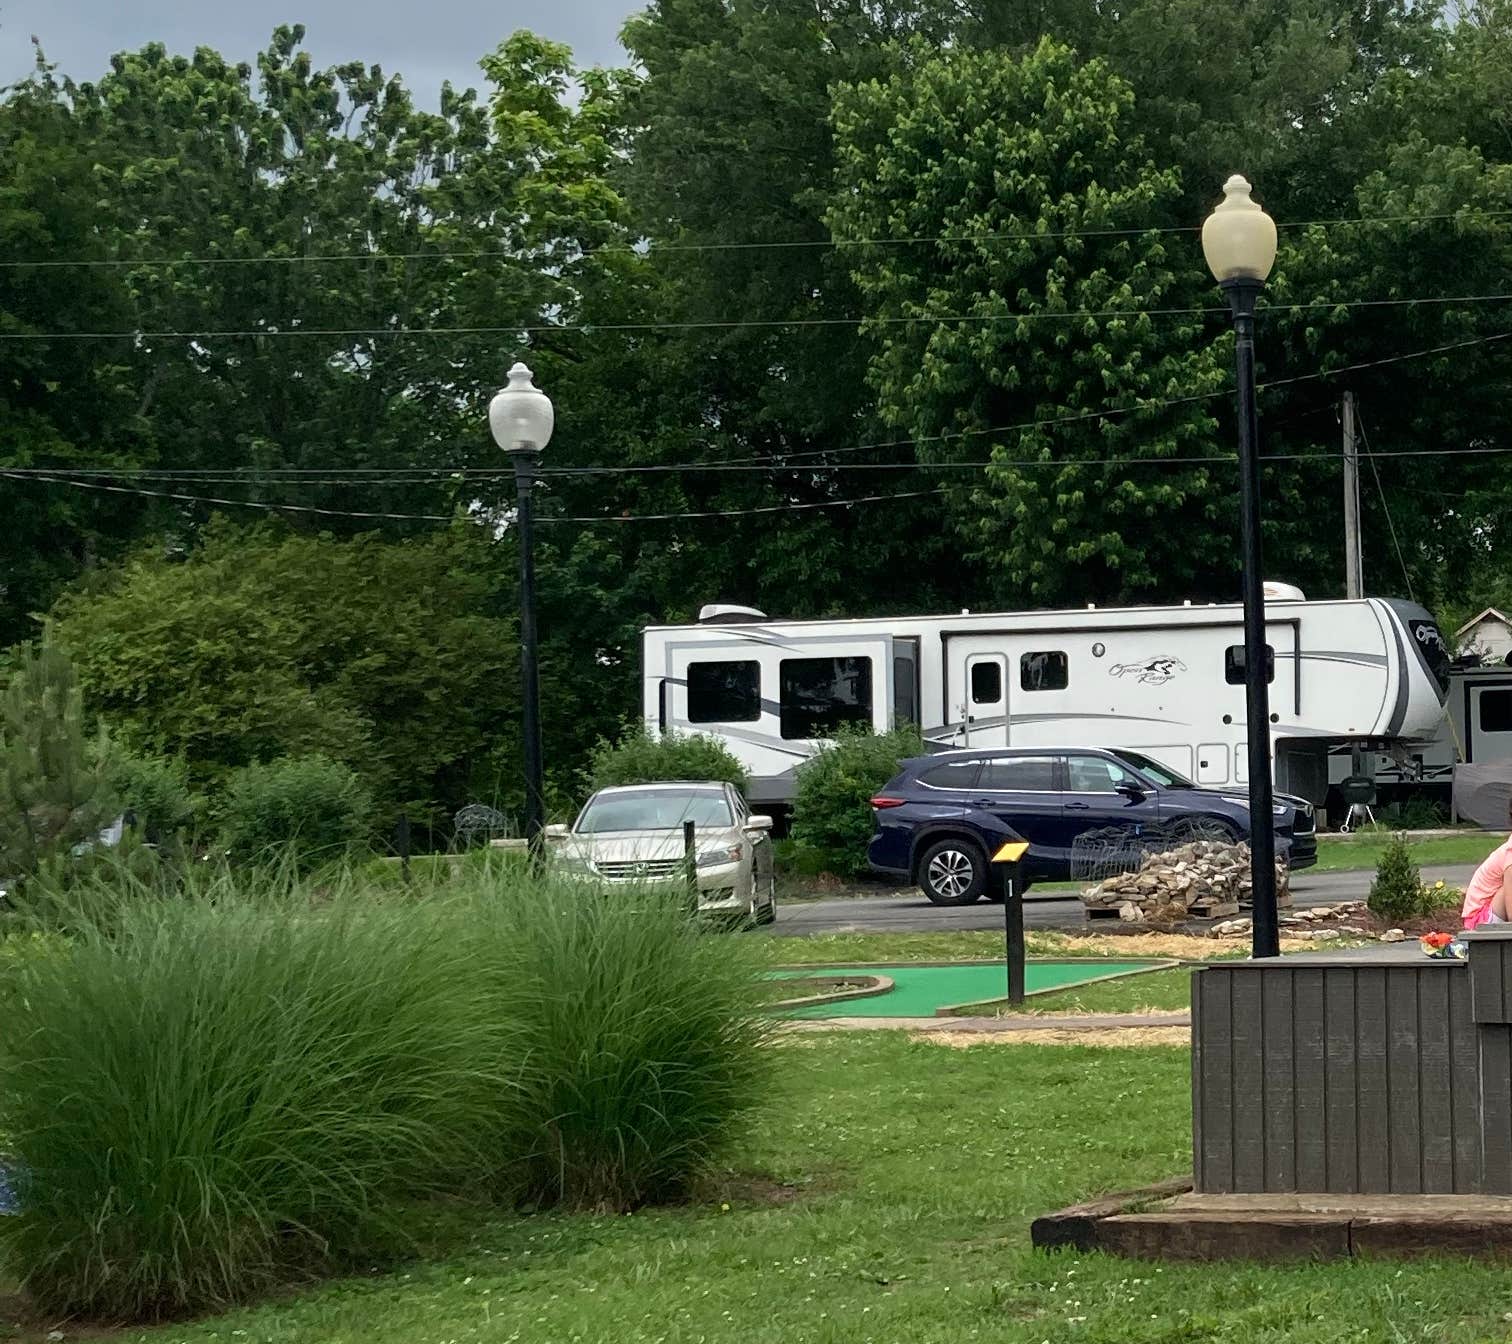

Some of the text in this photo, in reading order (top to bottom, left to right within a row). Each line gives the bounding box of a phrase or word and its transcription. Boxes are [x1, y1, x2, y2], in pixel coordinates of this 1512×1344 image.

[1108, 663, 1144, 678] Open
[1137, 672, 1175, 686] Range
[1008, 878, 1013, 897] 1
